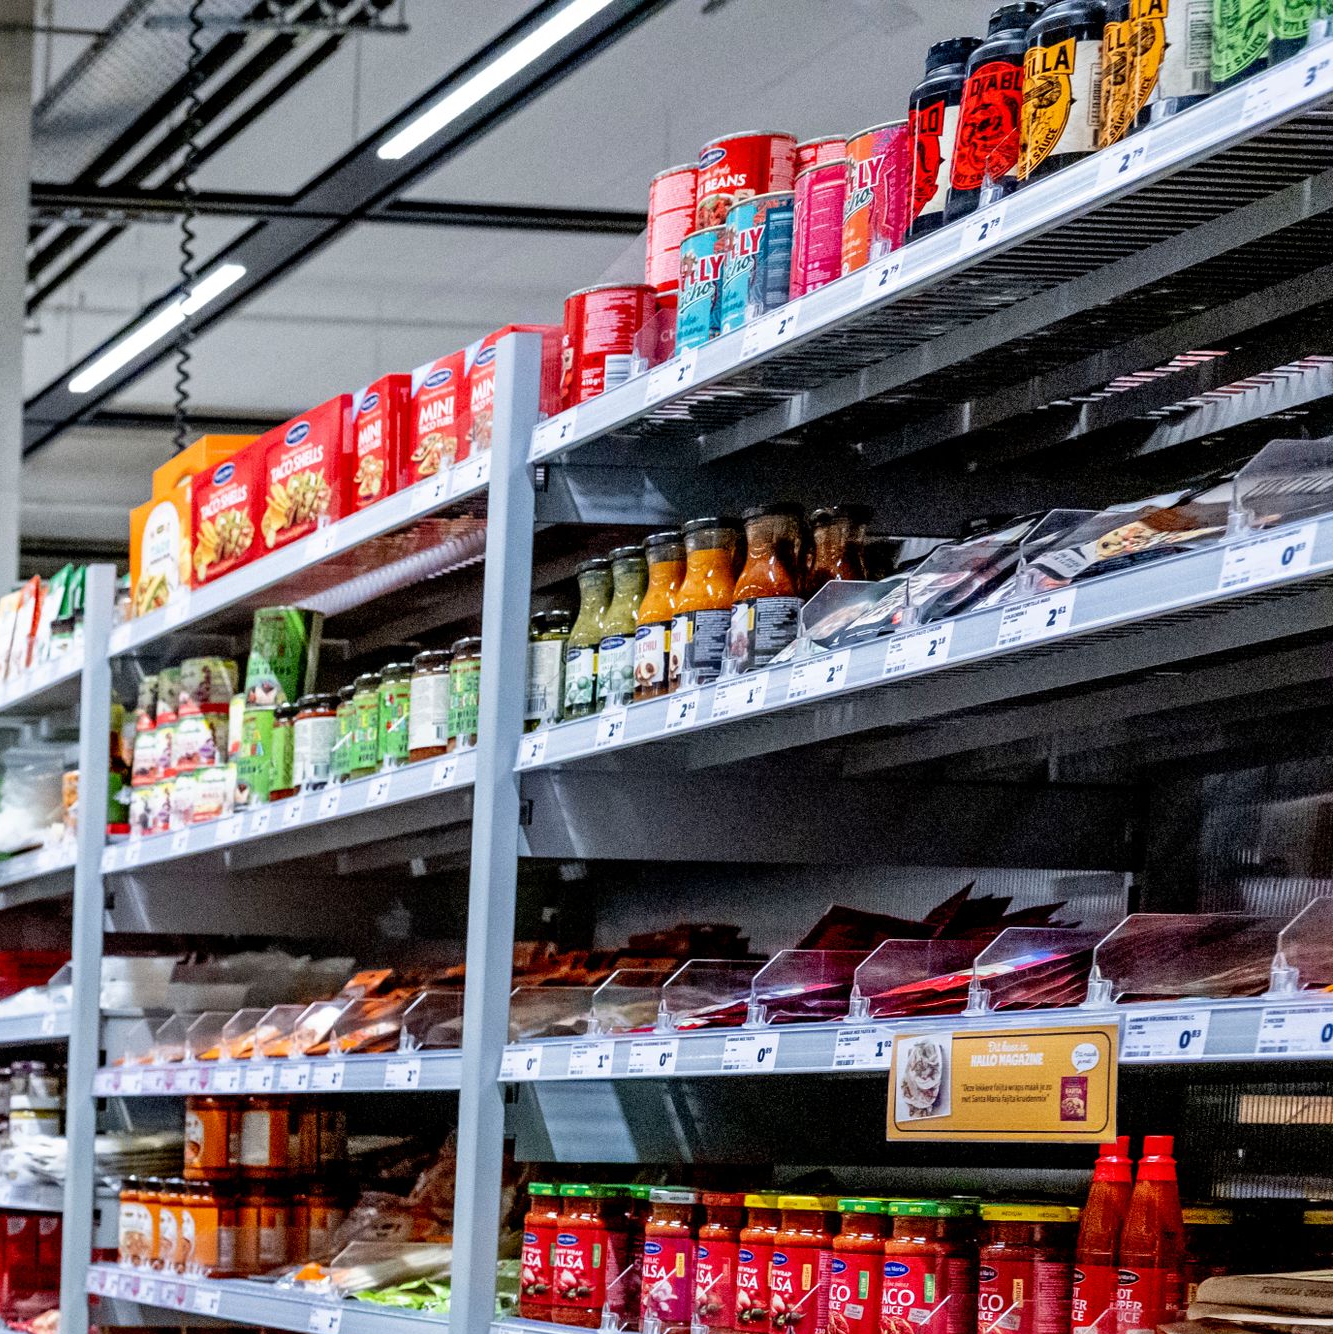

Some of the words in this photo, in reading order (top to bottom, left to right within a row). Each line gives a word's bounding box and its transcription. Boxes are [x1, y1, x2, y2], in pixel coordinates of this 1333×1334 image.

[1025, 45, 1071, 80] ILLA
[1032, 127, 1059, 162] SAUCE
[1118, 147, 1145, 174] 279
[704, 173, 747, 196] BEANS
[977, 216, 1001, 242] 279
[878, 263, 900, 288] 279
[418, 397, 455, 426] MINI
[357, 419, 383, 445] MINI
[270, 460, 293, 482] TACO
[293, 444, 324, 472] SHELLS
[220, 484, 248, 510] SHELLS
[998, 1053, 1044, 1066] MAGAZINE
